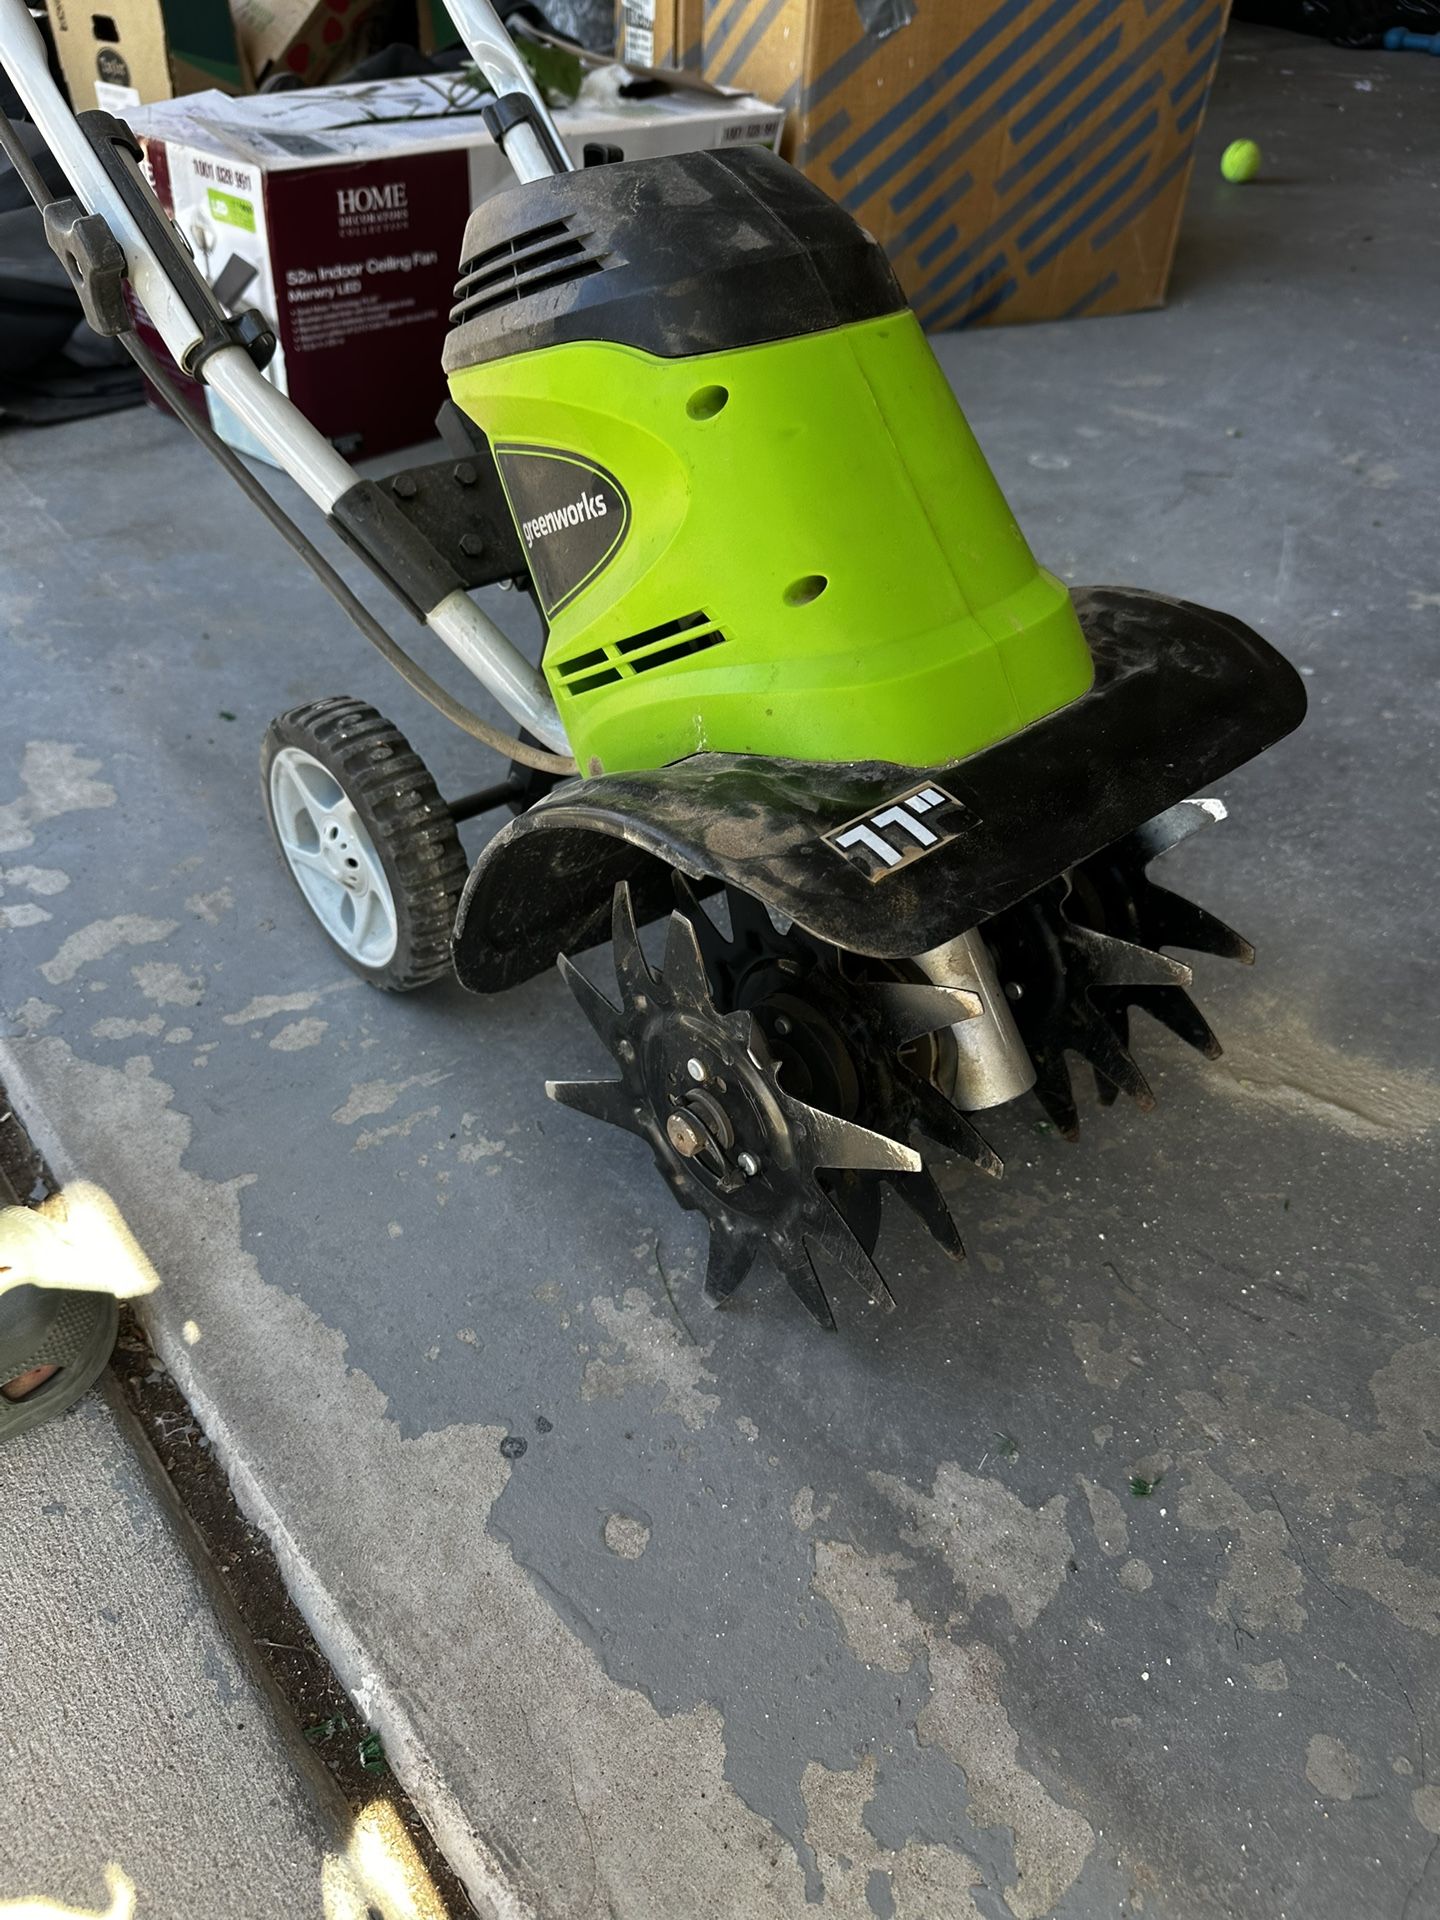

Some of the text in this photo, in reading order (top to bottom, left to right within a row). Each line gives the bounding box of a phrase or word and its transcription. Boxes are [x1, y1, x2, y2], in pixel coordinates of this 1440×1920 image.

[336, 182, 408, 215] HOME
[318, 262, 364, 280] Indoor
[365, 255, 412, 274] Ceiling
[412, 250, 438, 269] Fan
[336, 279, 362, 295] LED
[522, 491, 607, 549] greenworks
